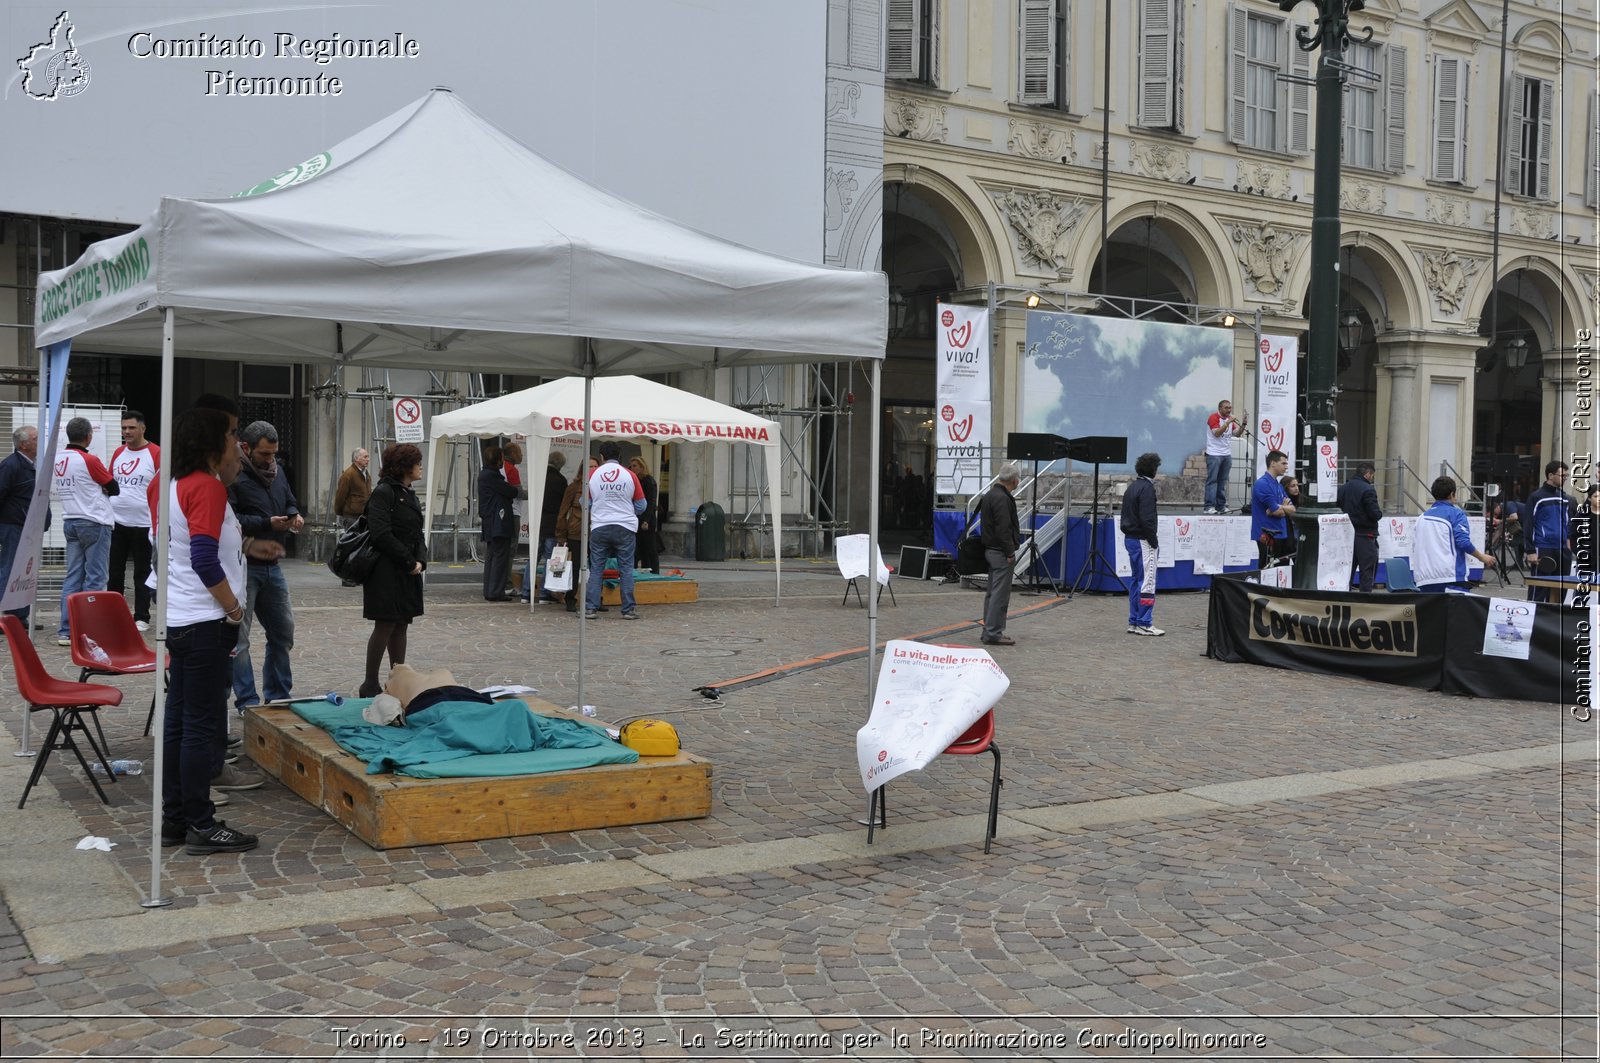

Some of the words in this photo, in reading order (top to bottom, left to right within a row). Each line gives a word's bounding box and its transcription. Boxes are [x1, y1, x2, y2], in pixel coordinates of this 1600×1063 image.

[41, 280, 69, 323] CROCE
[69, 262, 101, 310] VERDE
[101, 237, 150, 296] TORINO
[946, 347, 979, 363] viva!
[1263, 371, 1289, 385] viva!
[620, 420, 682, 436] ROSSA
[686, 424, 769, 441] ITALIANA
[600, 483, 626, 491] viva!
[1253, 597, 1415, 653] Cornilleau
[892, 658, 911, 666] come
[894, 648, 907, 657] La
[910, 650, 929, 661] vita
[932, 654, 959, 665] nelle
